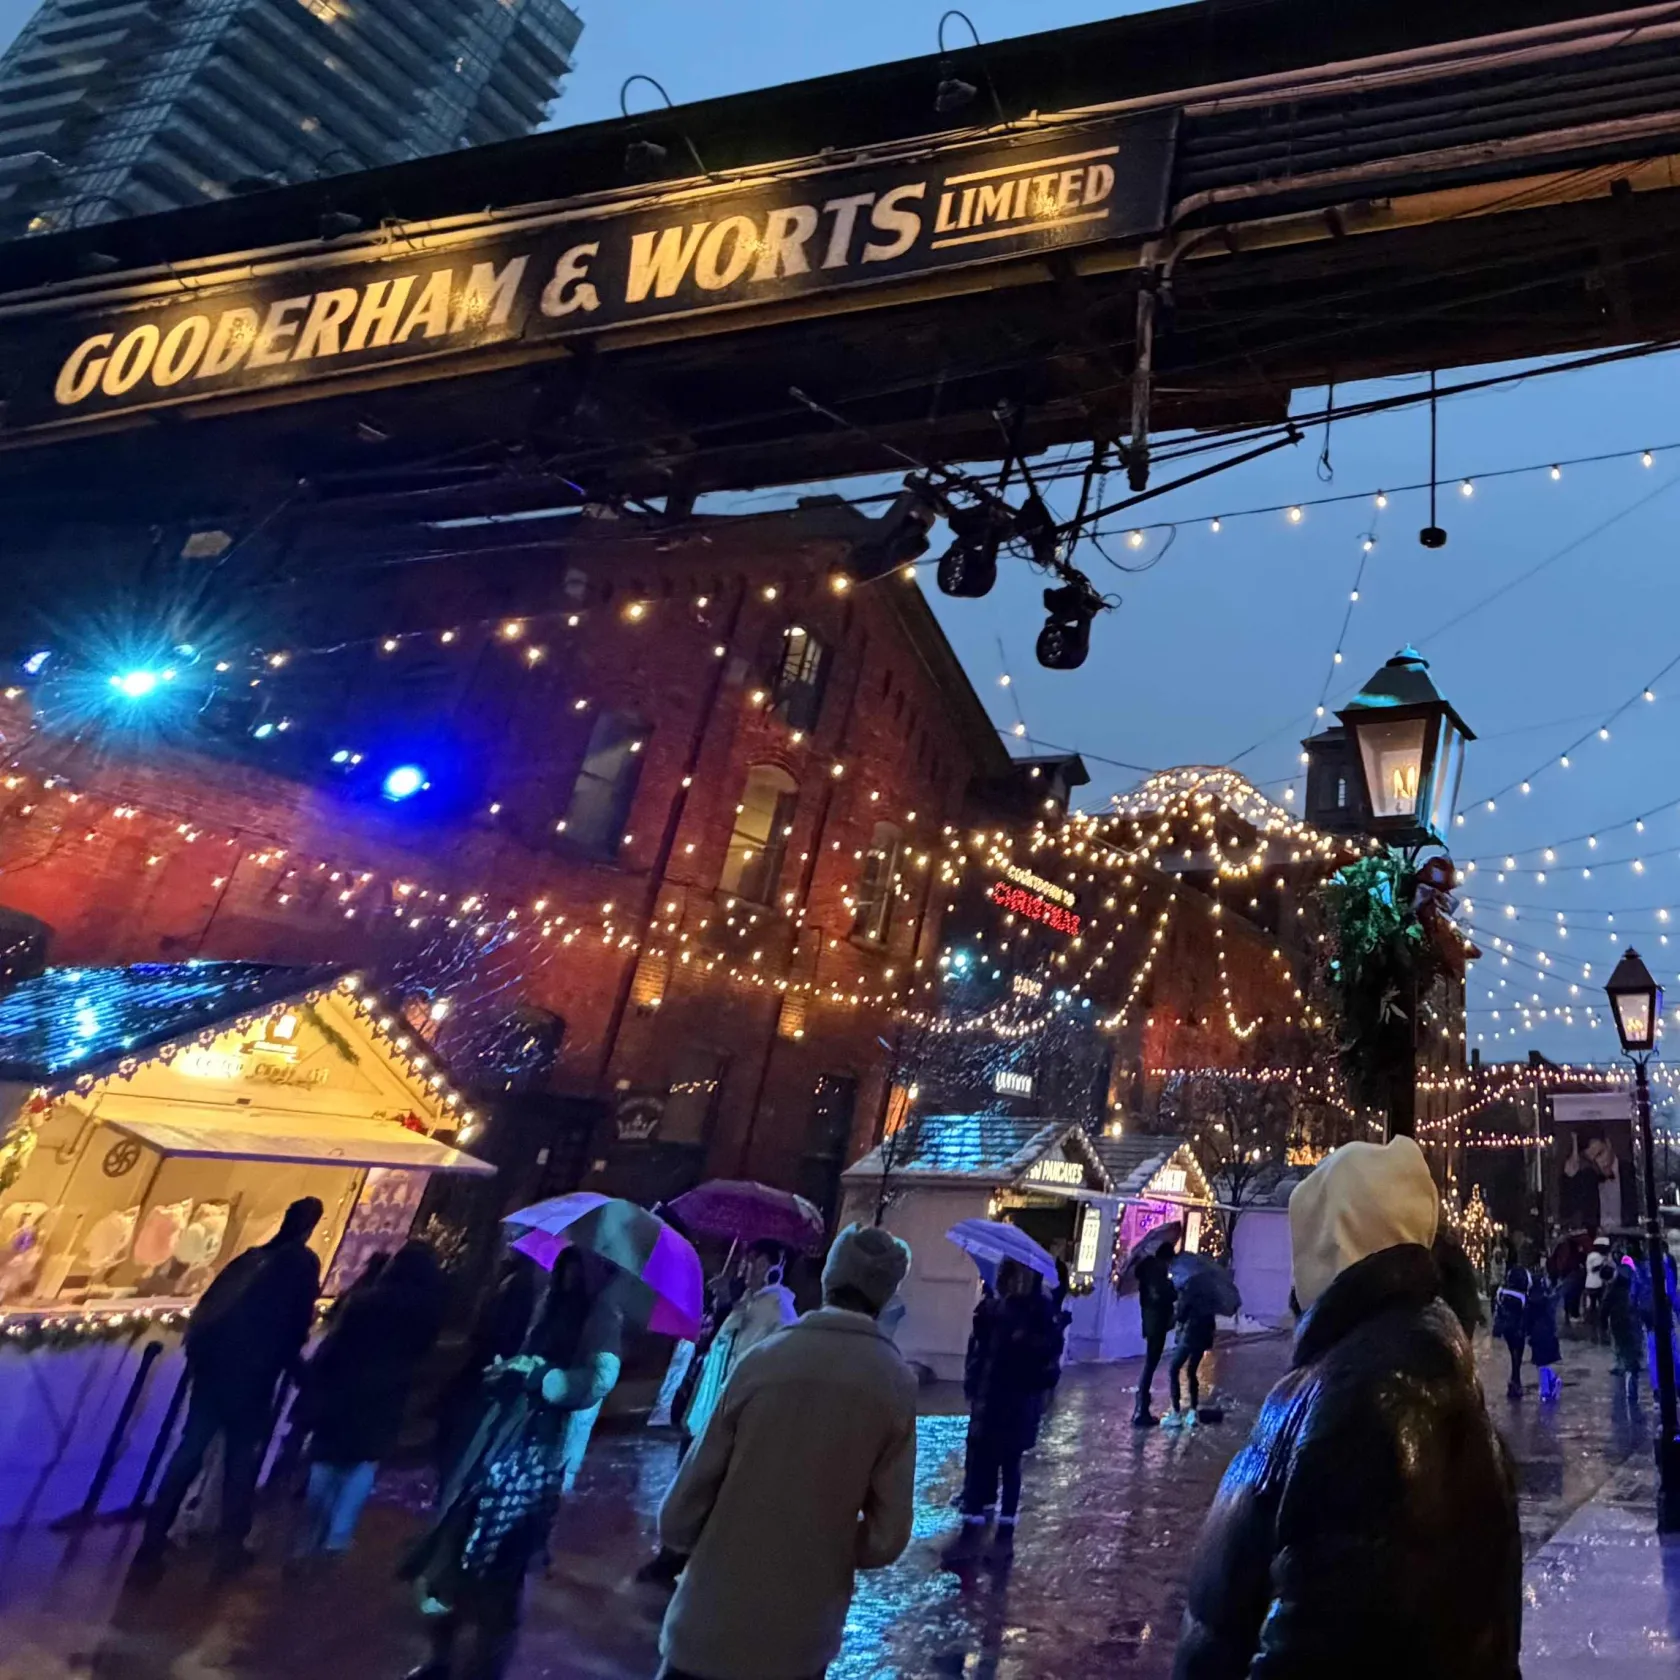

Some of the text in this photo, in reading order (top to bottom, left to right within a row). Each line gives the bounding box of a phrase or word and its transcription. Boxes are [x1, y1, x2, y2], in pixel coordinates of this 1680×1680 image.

[54, 163, 1115, 406] GOODERHAM & WORTS LIMITED
[1042, 1160, 1084, 1184] PANCAKES
